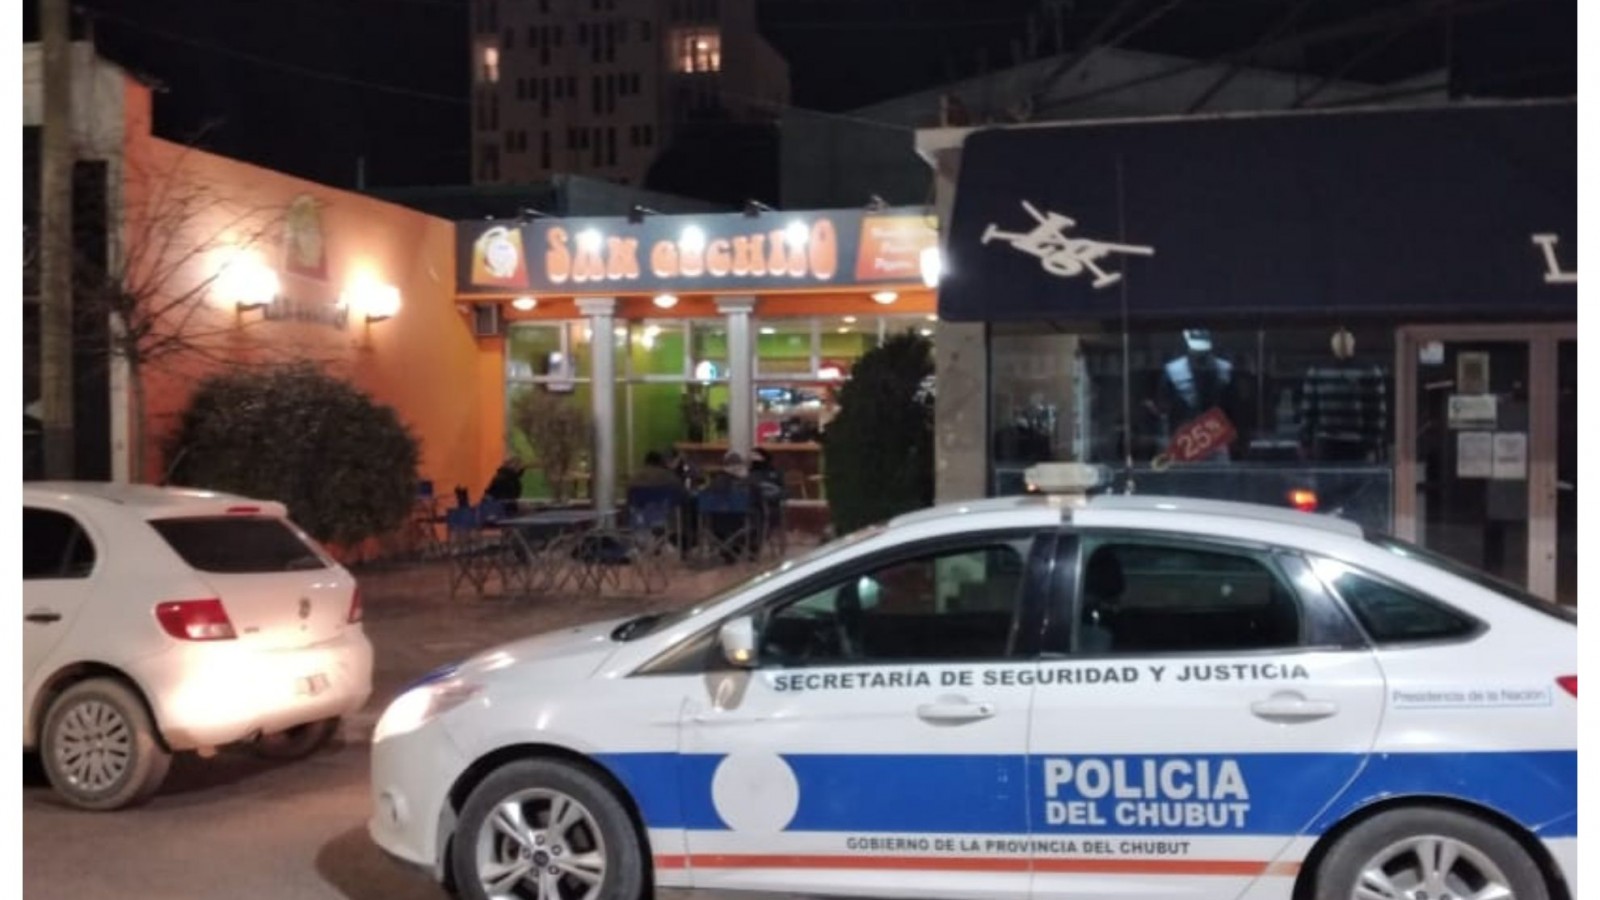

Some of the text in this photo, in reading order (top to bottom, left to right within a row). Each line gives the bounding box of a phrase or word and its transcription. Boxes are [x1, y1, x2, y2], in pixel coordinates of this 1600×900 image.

[545, 226, 640, 282] SAN
[774, 663, 1310, 691] SECRETARÍA DE SEGURIDAD Y JUSTICIA
[1392, 690, 1465, 702] Presidencia
[1468, 690, 1483, 701] de
[1486, 690, 1498, 701] la
[1044, 758, 1249, 801] POLICIA
[1046, 801, 1250, 828] DEL CHUBUT
[846, 838, 1191, 855] GOBIERNO DE LA PROVINCIA DEL CHUBUT
